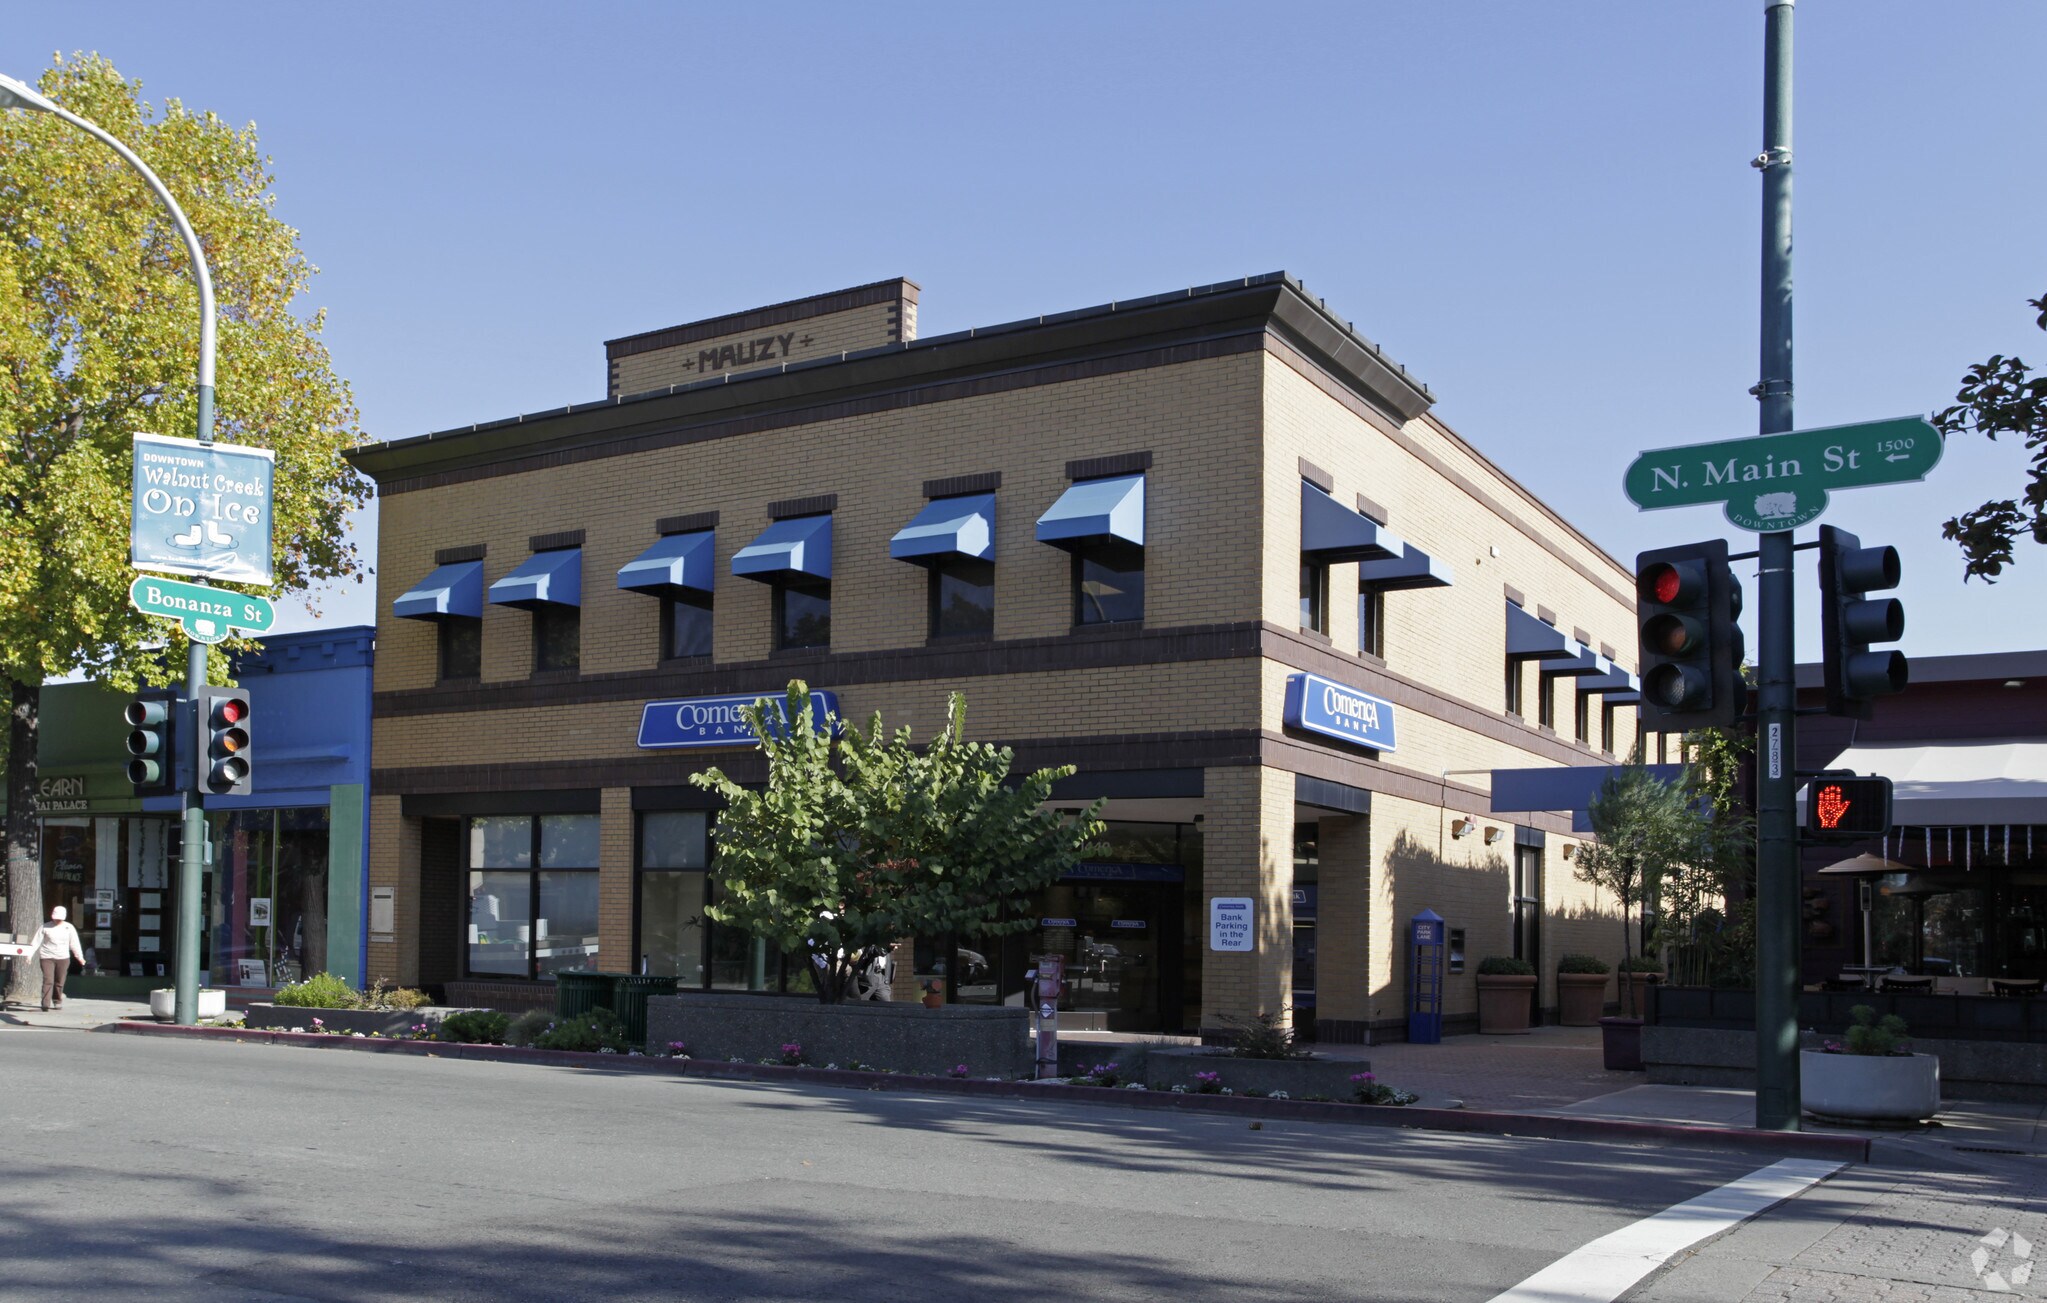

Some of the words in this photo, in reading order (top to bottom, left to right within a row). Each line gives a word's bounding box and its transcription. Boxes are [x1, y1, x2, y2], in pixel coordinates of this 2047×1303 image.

[699, 332, 794, 373] MAUZY
[1876, 438, 1915, 453] 1500
[143, 453, 204, 468] DOWNTOWN
[1651, 464, 1689, 492] N.
[1702, 454, 1803, 486] Main
[1823, 445, 1861, 473] St
[142, 465, 210, 490] Walnut
[214, 475, 264, 497] Creek
[142, 488, 196, 517] On
[212, 493, 260, 525] Ice
[1734, 506, 1819, 529] DOWNTOWN
[146, 586, 233, 618] Bonanza
[244, 605, 263, 623] St
[699, 725, 757, 736] BAN
[1336, 715, 1368, 733] BANK
[1771, 727, 1779, 775] 2783
[52, 800, 87, 811] PALACE
[1215, 922, 1248, 931] Parking
[1221, 913, 1243, 921] Bank
